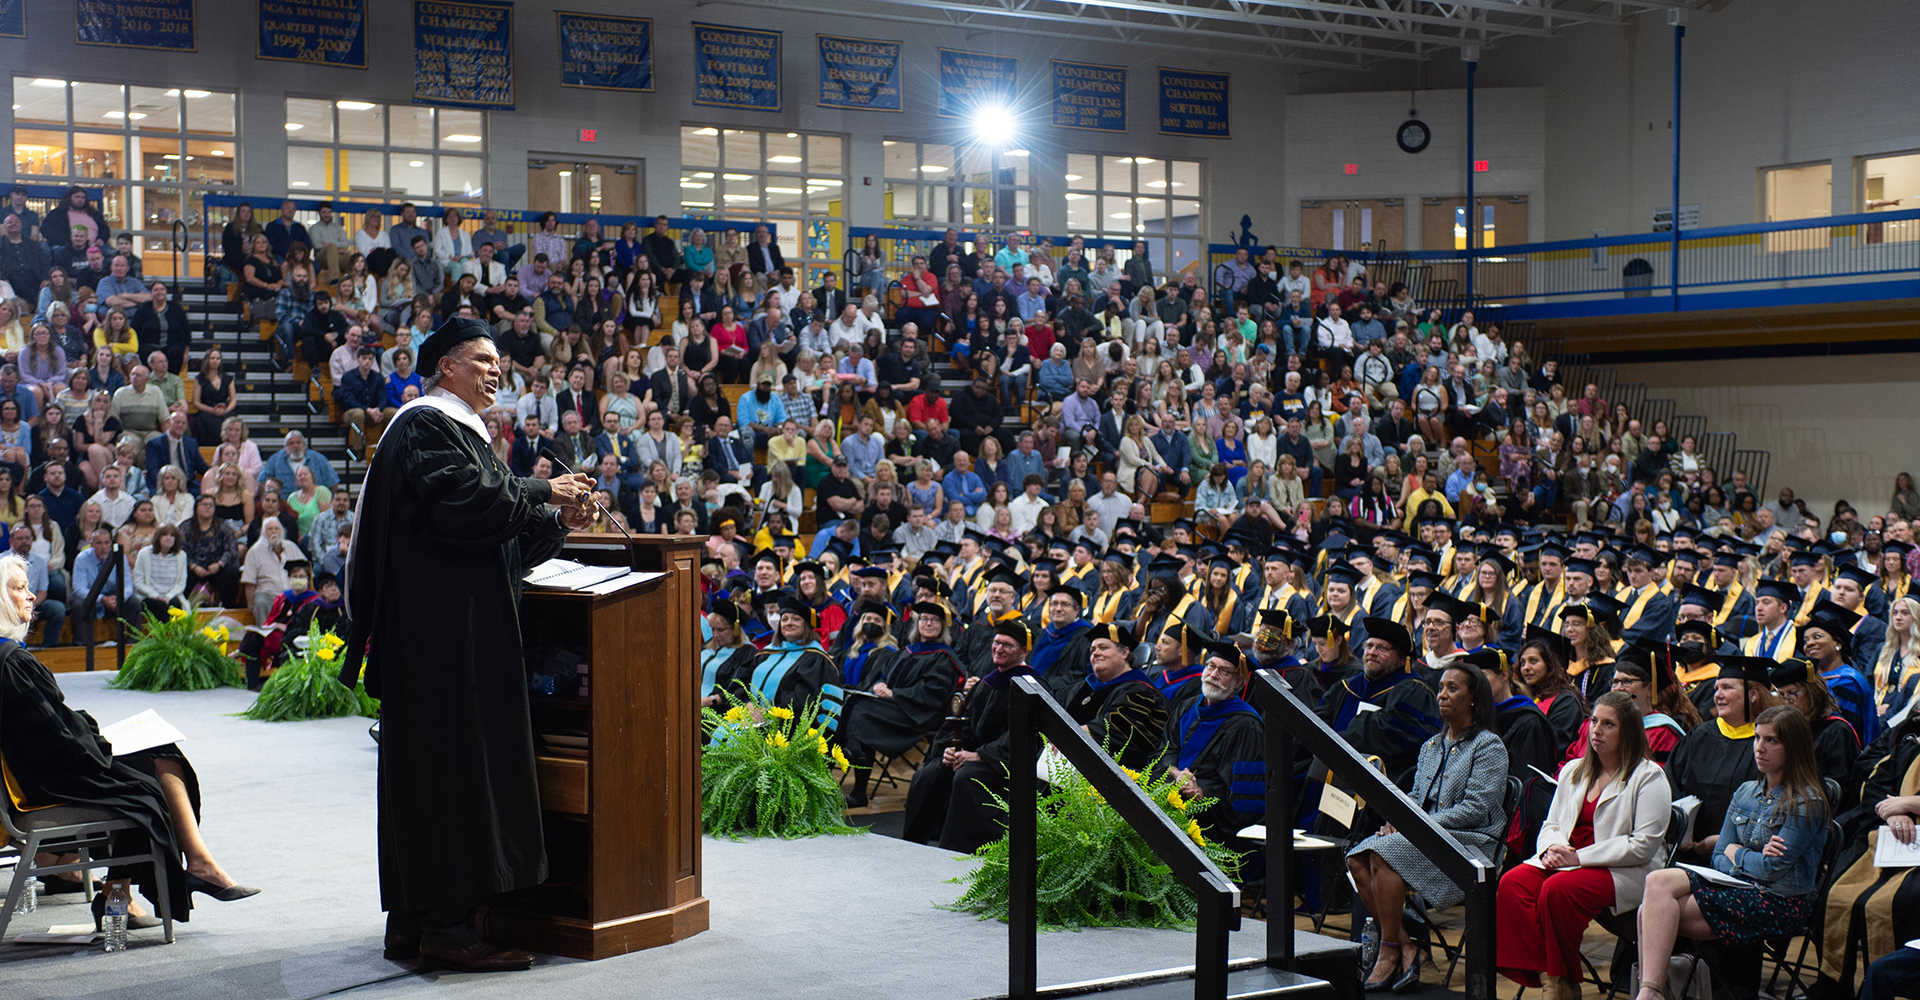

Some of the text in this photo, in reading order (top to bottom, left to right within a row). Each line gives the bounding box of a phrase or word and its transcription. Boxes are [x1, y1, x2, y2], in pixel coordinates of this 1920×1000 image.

[116, 5, 192, 20] BASKETBALL
[262, 2, 292, 14] NCAA
[297, 8, 344, 20] DIVISION
[420, 2, 504, 20] CONFERENCE
[121, 19, 151, 31] 2016
[159, 22, 189, 34] 2018
[264, 20, 356, 37] QUARTER FINALS
[421, 15, 498, 32] CHAMPIONS
[567, 19, 644, 34] CONFERENCE
[273, 34, 351, 52] 1999 2000
[423, 34, 503, 51] VOLLEYBALL
[570, 31, 640, 46] CHAMPIONS
[701, 31, 775, 48] CONFERENCE
[298, 48, 325, 61] 2001
[703, 44, 771, 60] CHAMPIONS
[822, 39, 897, 56] CONFERENCE
[478, 54, 506, 66] 2000
[569, 49, 642, 64] VOLLEYBALL
[825, 52, 894, 68] CHAMPIONS
[955, 58, 1002, 70] WRESTLING
[421, 61, 446, 72] 2001
[564, 62, 618, 75] 2011 2012
[707, 60, 766, 75] FOOTBALL
[1056, 66, 1125, 81] CONFERENCE
[699, 74, 776, 90] 2004 2005 2006
[829, 68, 889, 84] BASEBALL
[1163, 77, 1225, 90] CONFERENCE
[1060, 78, 1121, 93] CHAMPIONS
[699, 88, 725, 99] 2009
[1060, 94, 1121, 108] WRESTLING
[1166, 89, 1223, 102] CHAMPIONS
[1170, 103, 1218, 116] SOFTBALL
[1080, 117, 1098, 126] 2011
[1207, 121, 1226, 130] 2019
[1277, 248, 1314, 256] ECTION
